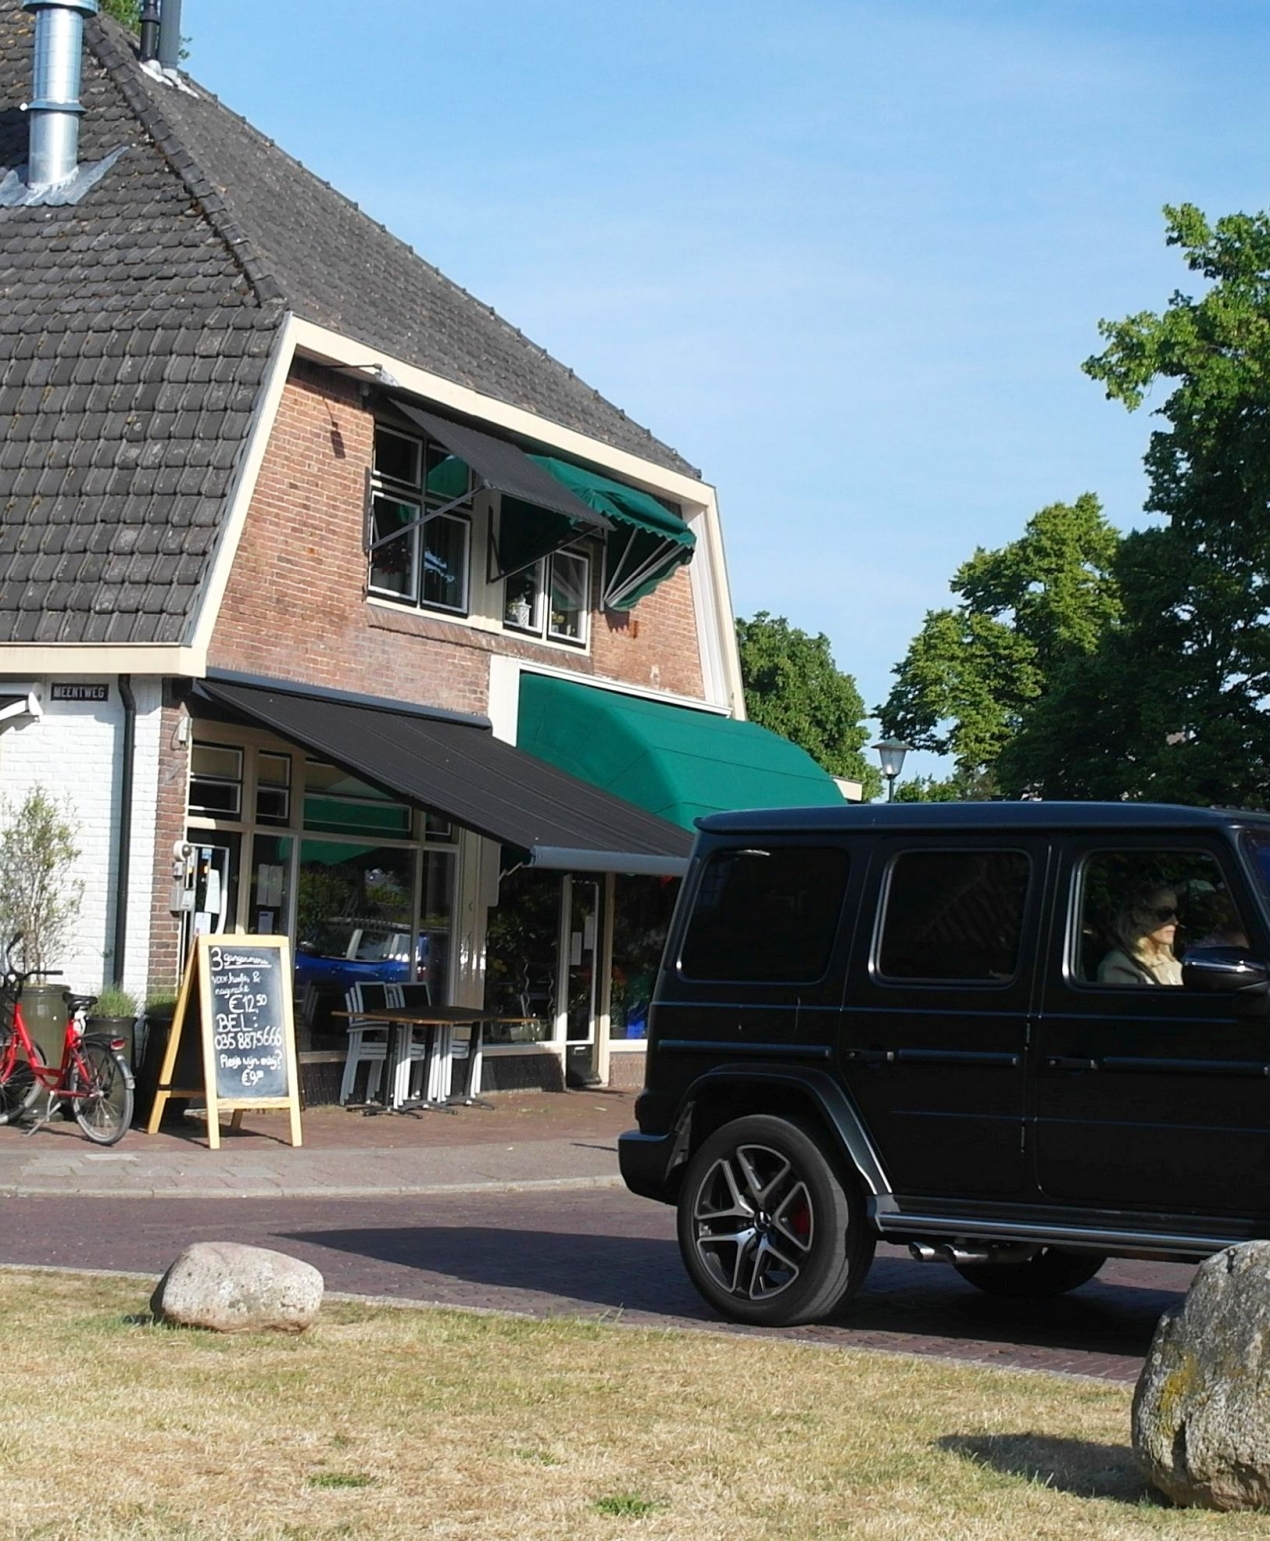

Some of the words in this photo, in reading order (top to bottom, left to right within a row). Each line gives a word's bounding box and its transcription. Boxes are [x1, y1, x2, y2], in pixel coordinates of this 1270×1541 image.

[53, 686, 105, 698] MEENTWEG
[211, 947, 223, 971] 3
[216, 1013, 259, 1032] BEL:
[214, 1033, 236, 1050] 035
